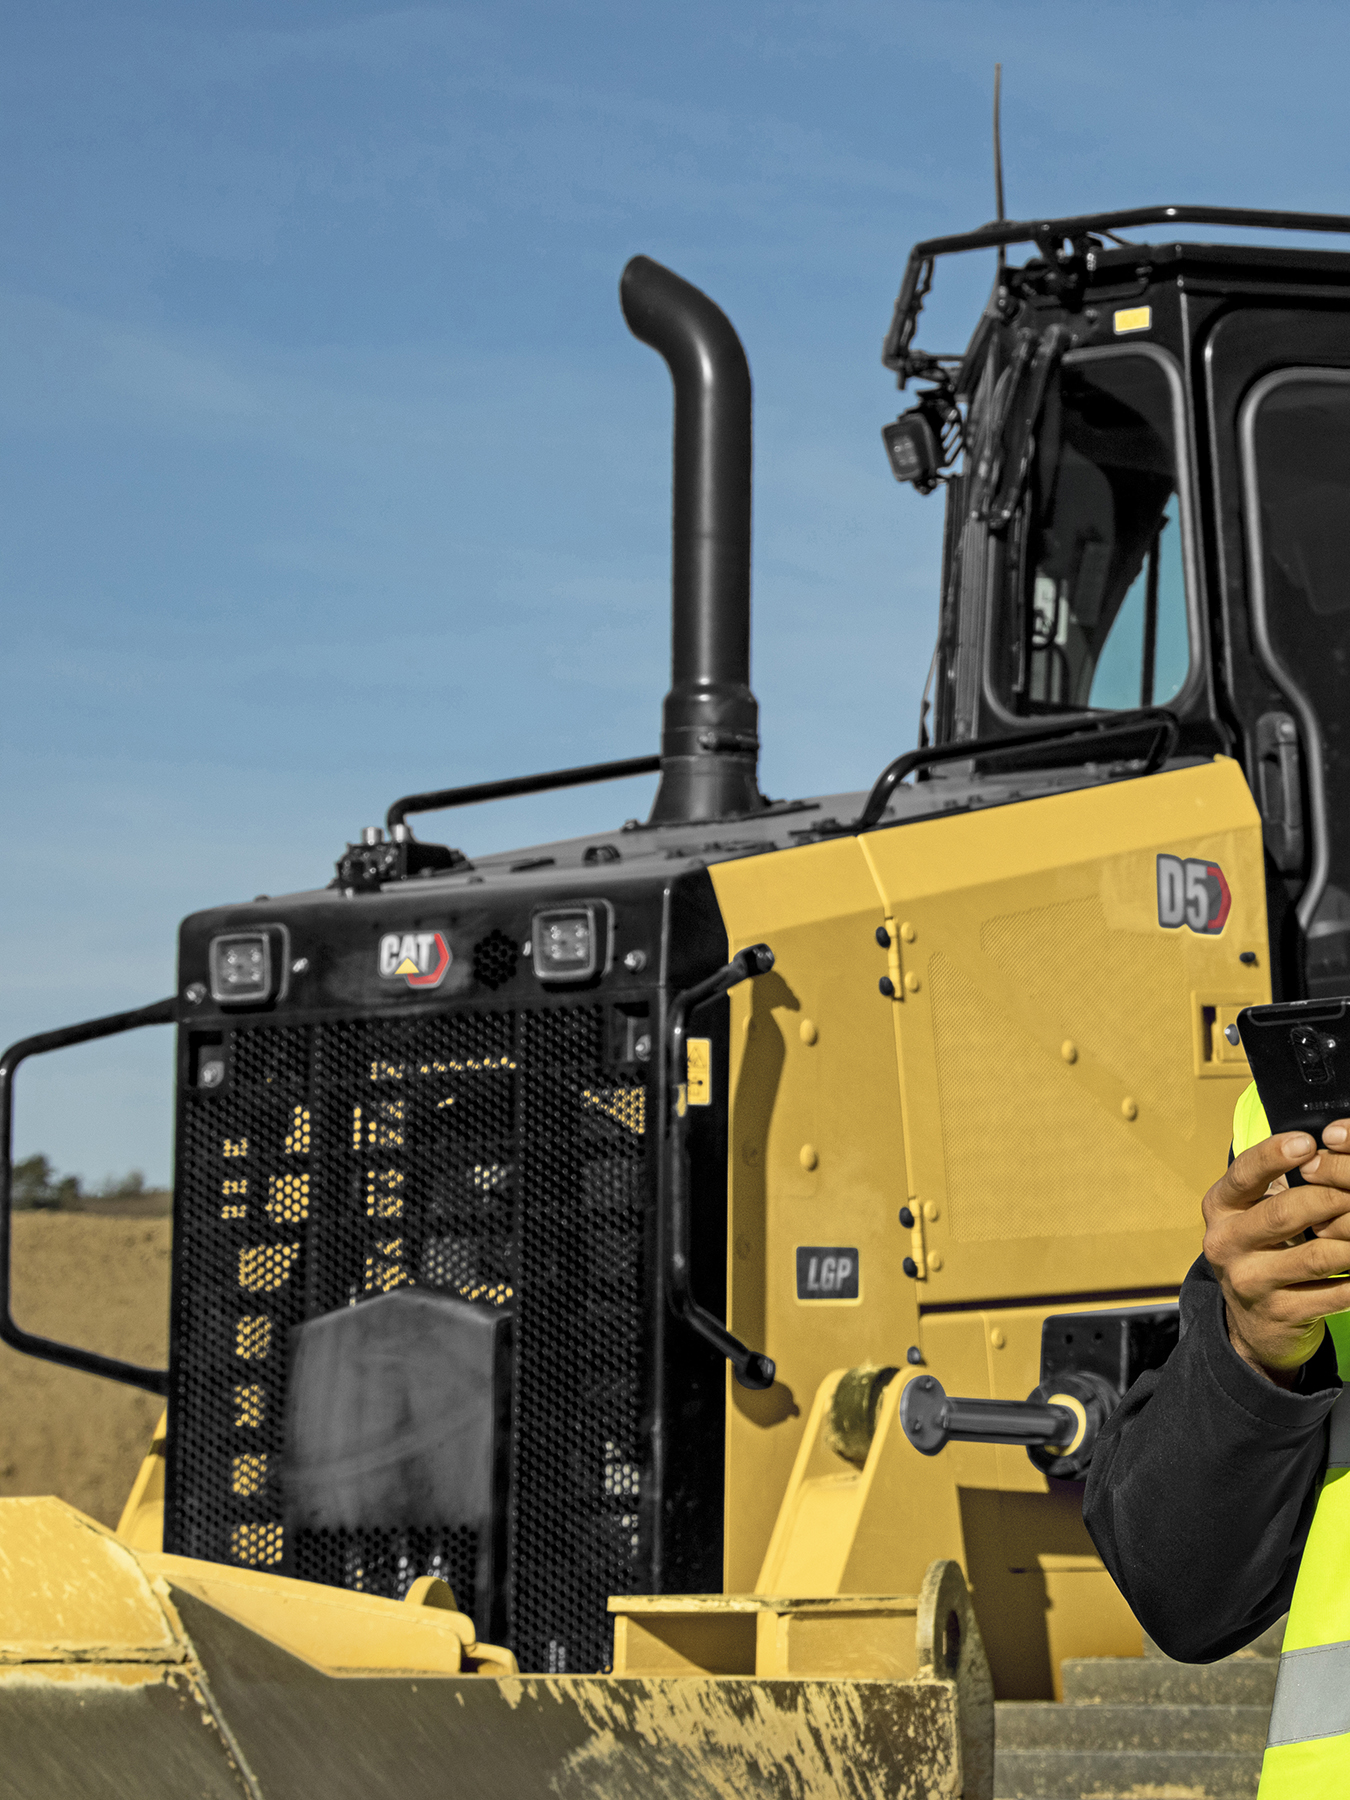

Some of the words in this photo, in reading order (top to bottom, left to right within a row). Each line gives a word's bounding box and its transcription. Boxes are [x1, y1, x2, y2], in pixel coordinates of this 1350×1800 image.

[1160, 858, 1208, 929] D5
[381, 933, 434, 975] CAT
[807, 1256, 853, 1291] LGP
